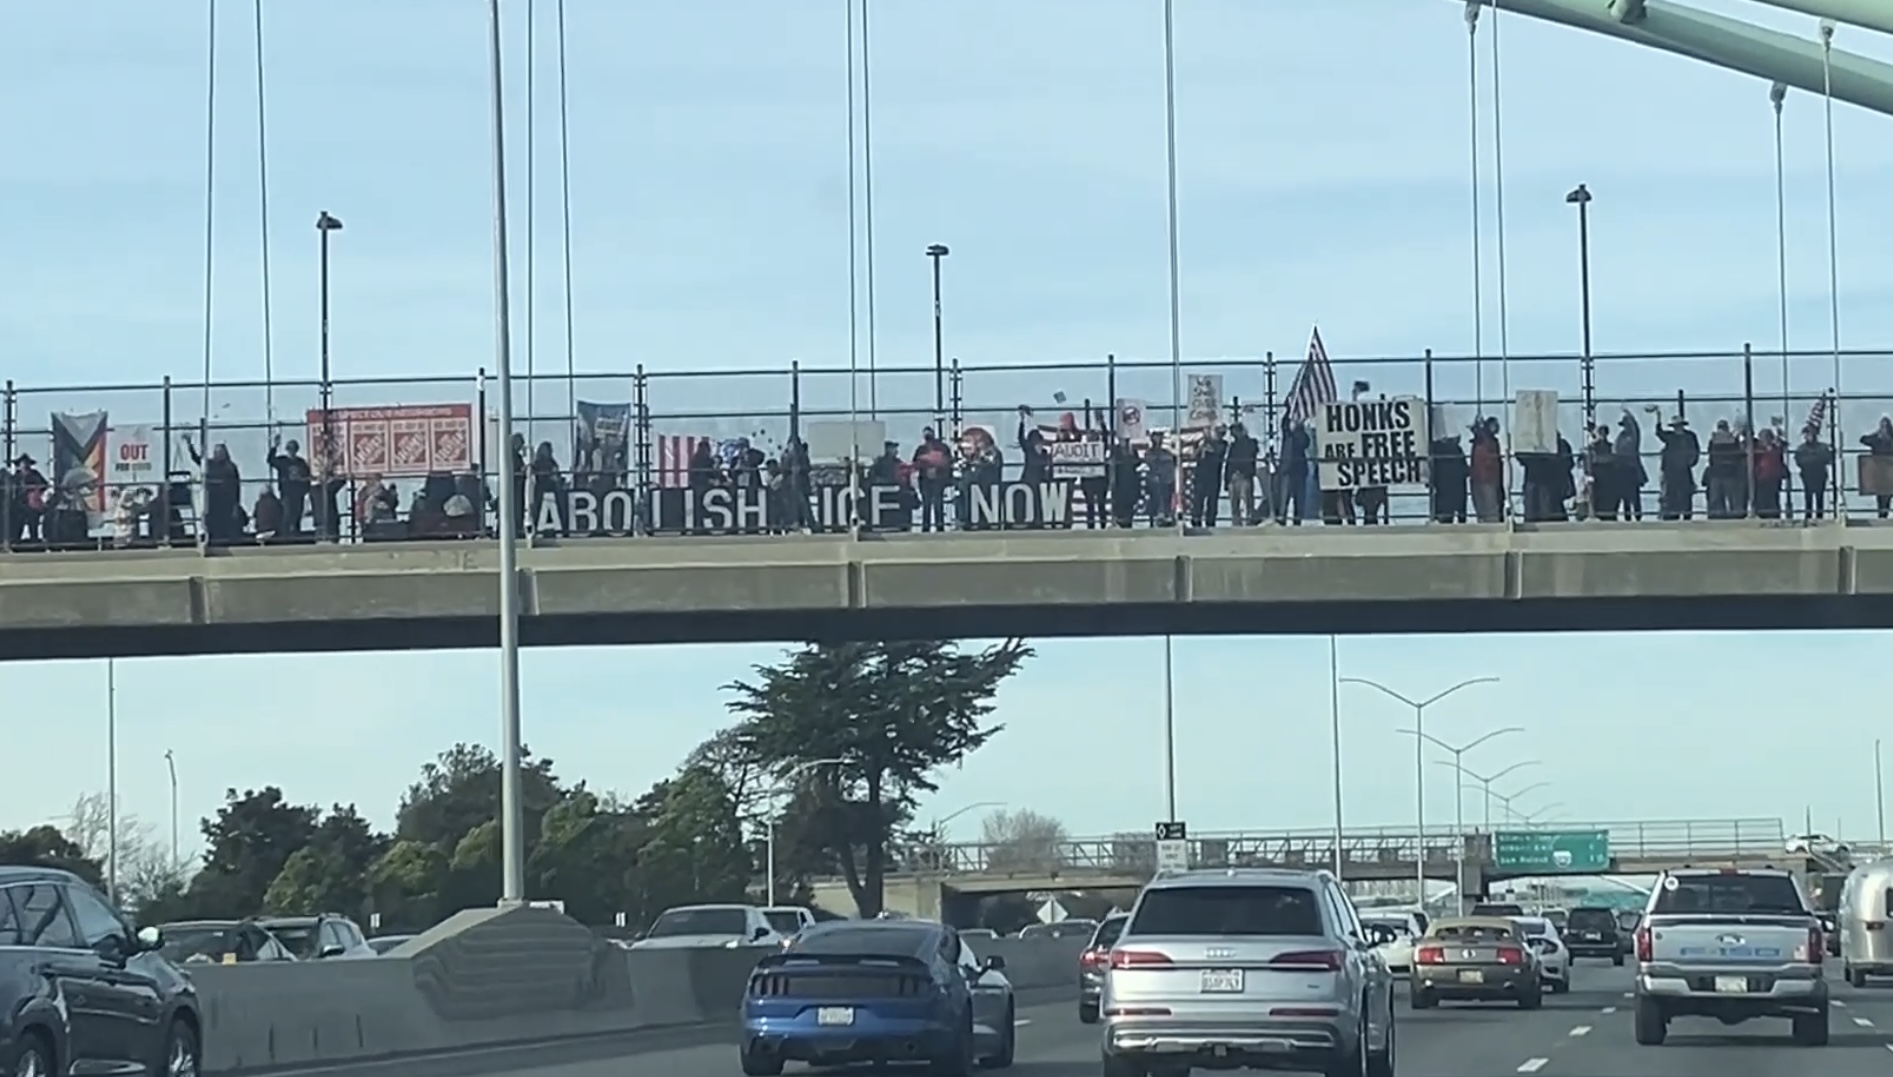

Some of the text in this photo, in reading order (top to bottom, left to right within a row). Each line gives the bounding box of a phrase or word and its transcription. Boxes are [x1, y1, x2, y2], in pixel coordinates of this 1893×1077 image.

[1326, 401, 1410, 432] HONKS
[120, 443, 149, 460] OUT
[1324, 430, 1417, 459] ARE FREE
[1337, 459, 1420, 486] SPEECH
[536, 482, 1068, 536] ABOLISH ICE NOW
